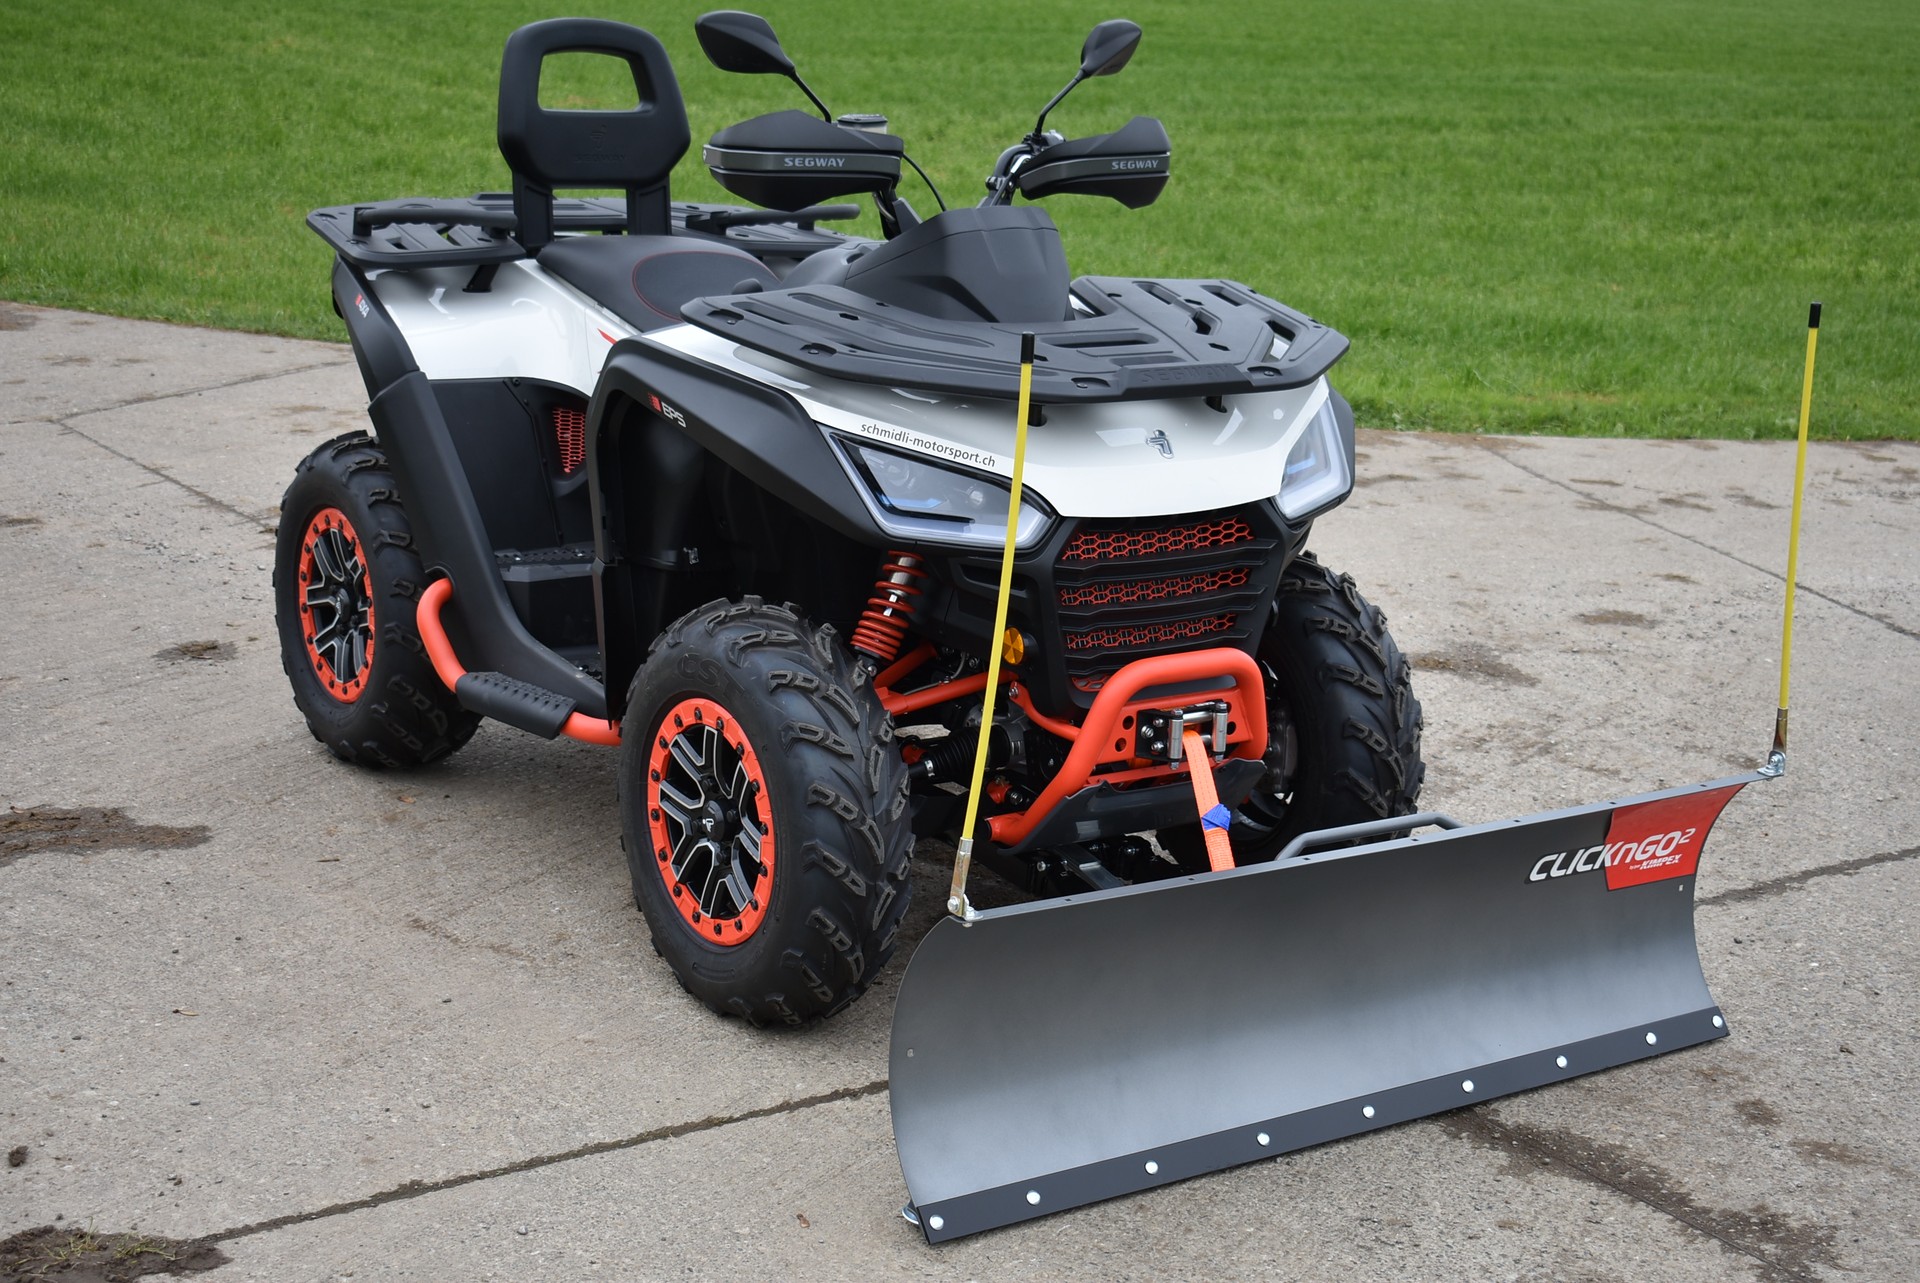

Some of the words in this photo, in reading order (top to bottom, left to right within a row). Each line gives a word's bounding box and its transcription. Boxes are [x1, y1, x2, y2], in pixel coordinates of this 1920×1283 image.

[783, 157, 846, 168] SEGWAY
[1111, 159, 1159, 170] SEGWAY
[661, 401, 687, 428] EPS
[860, 423, 996, 468] schmidli-motorsport.ch
[677, 652, 745, 705] CST
